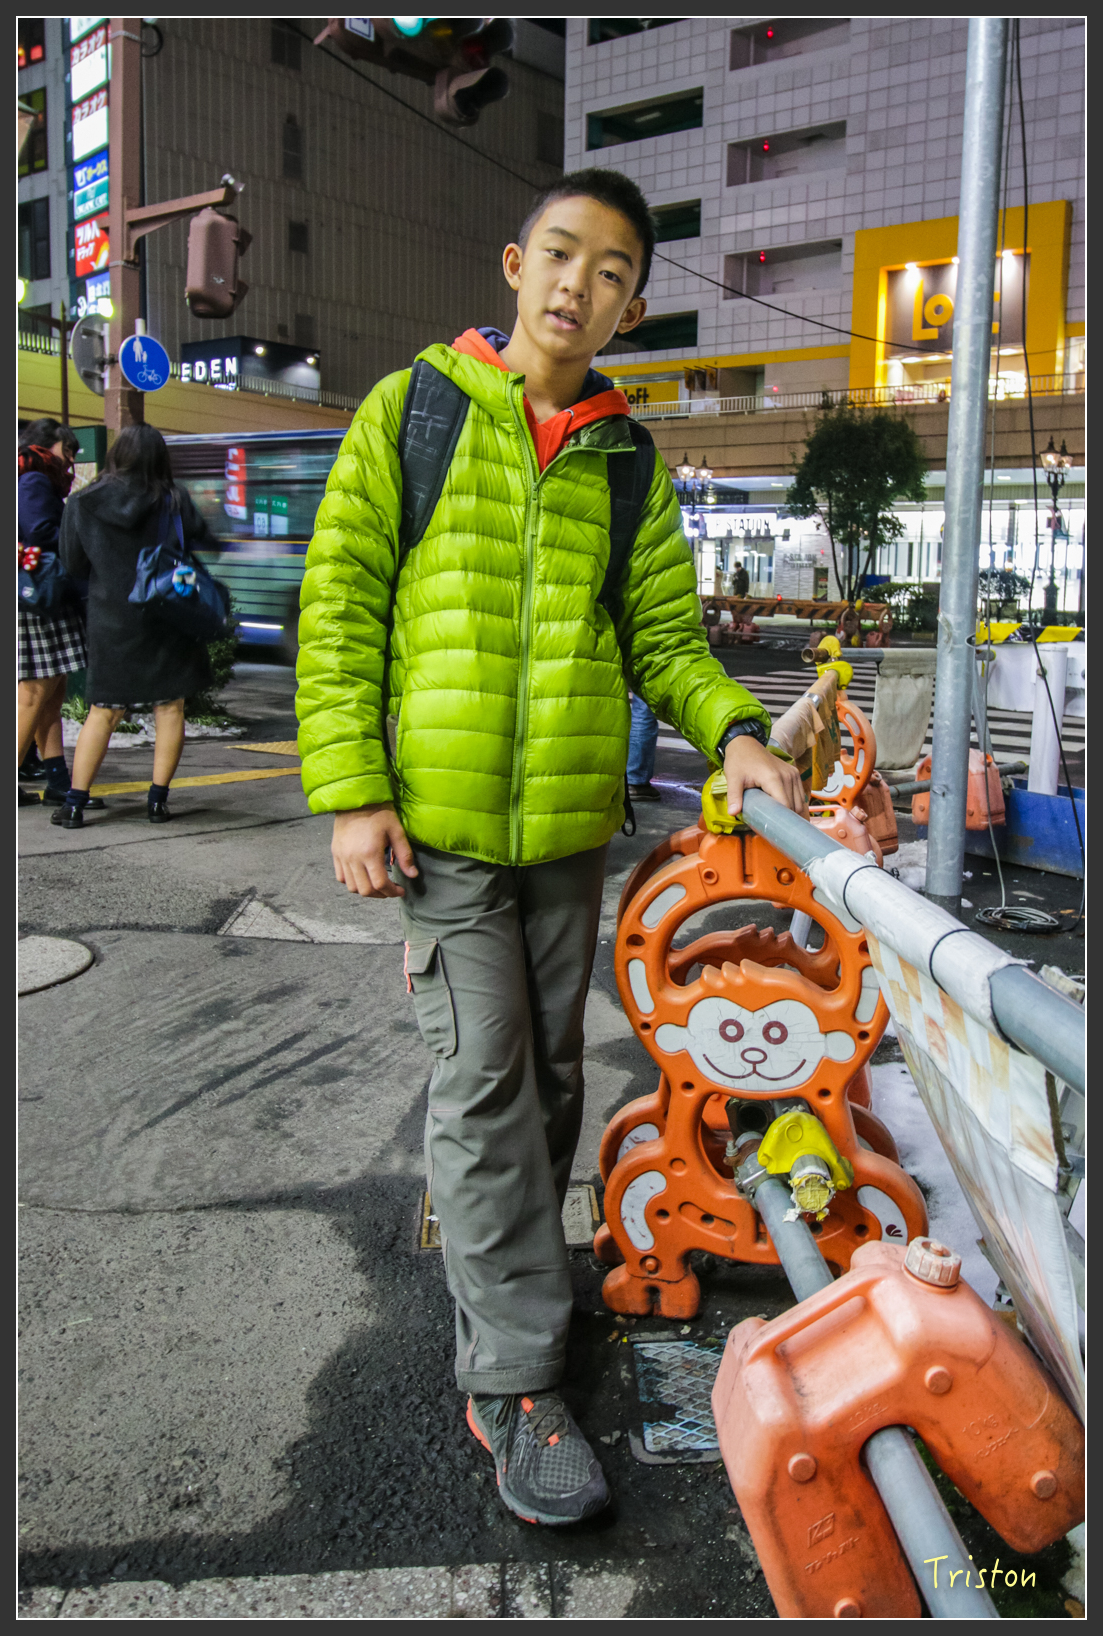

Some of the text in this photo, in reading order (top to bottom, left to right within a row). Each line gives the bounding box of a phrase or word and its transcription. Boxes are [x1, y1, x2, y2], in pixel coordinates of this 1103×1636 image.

[72, 28, 105, 66] カラオケ
[73, 90, 107, 125] カラオケ
[76, 220, 100, 246] ツルハ
[181, 356, 238, 382] EDEN
